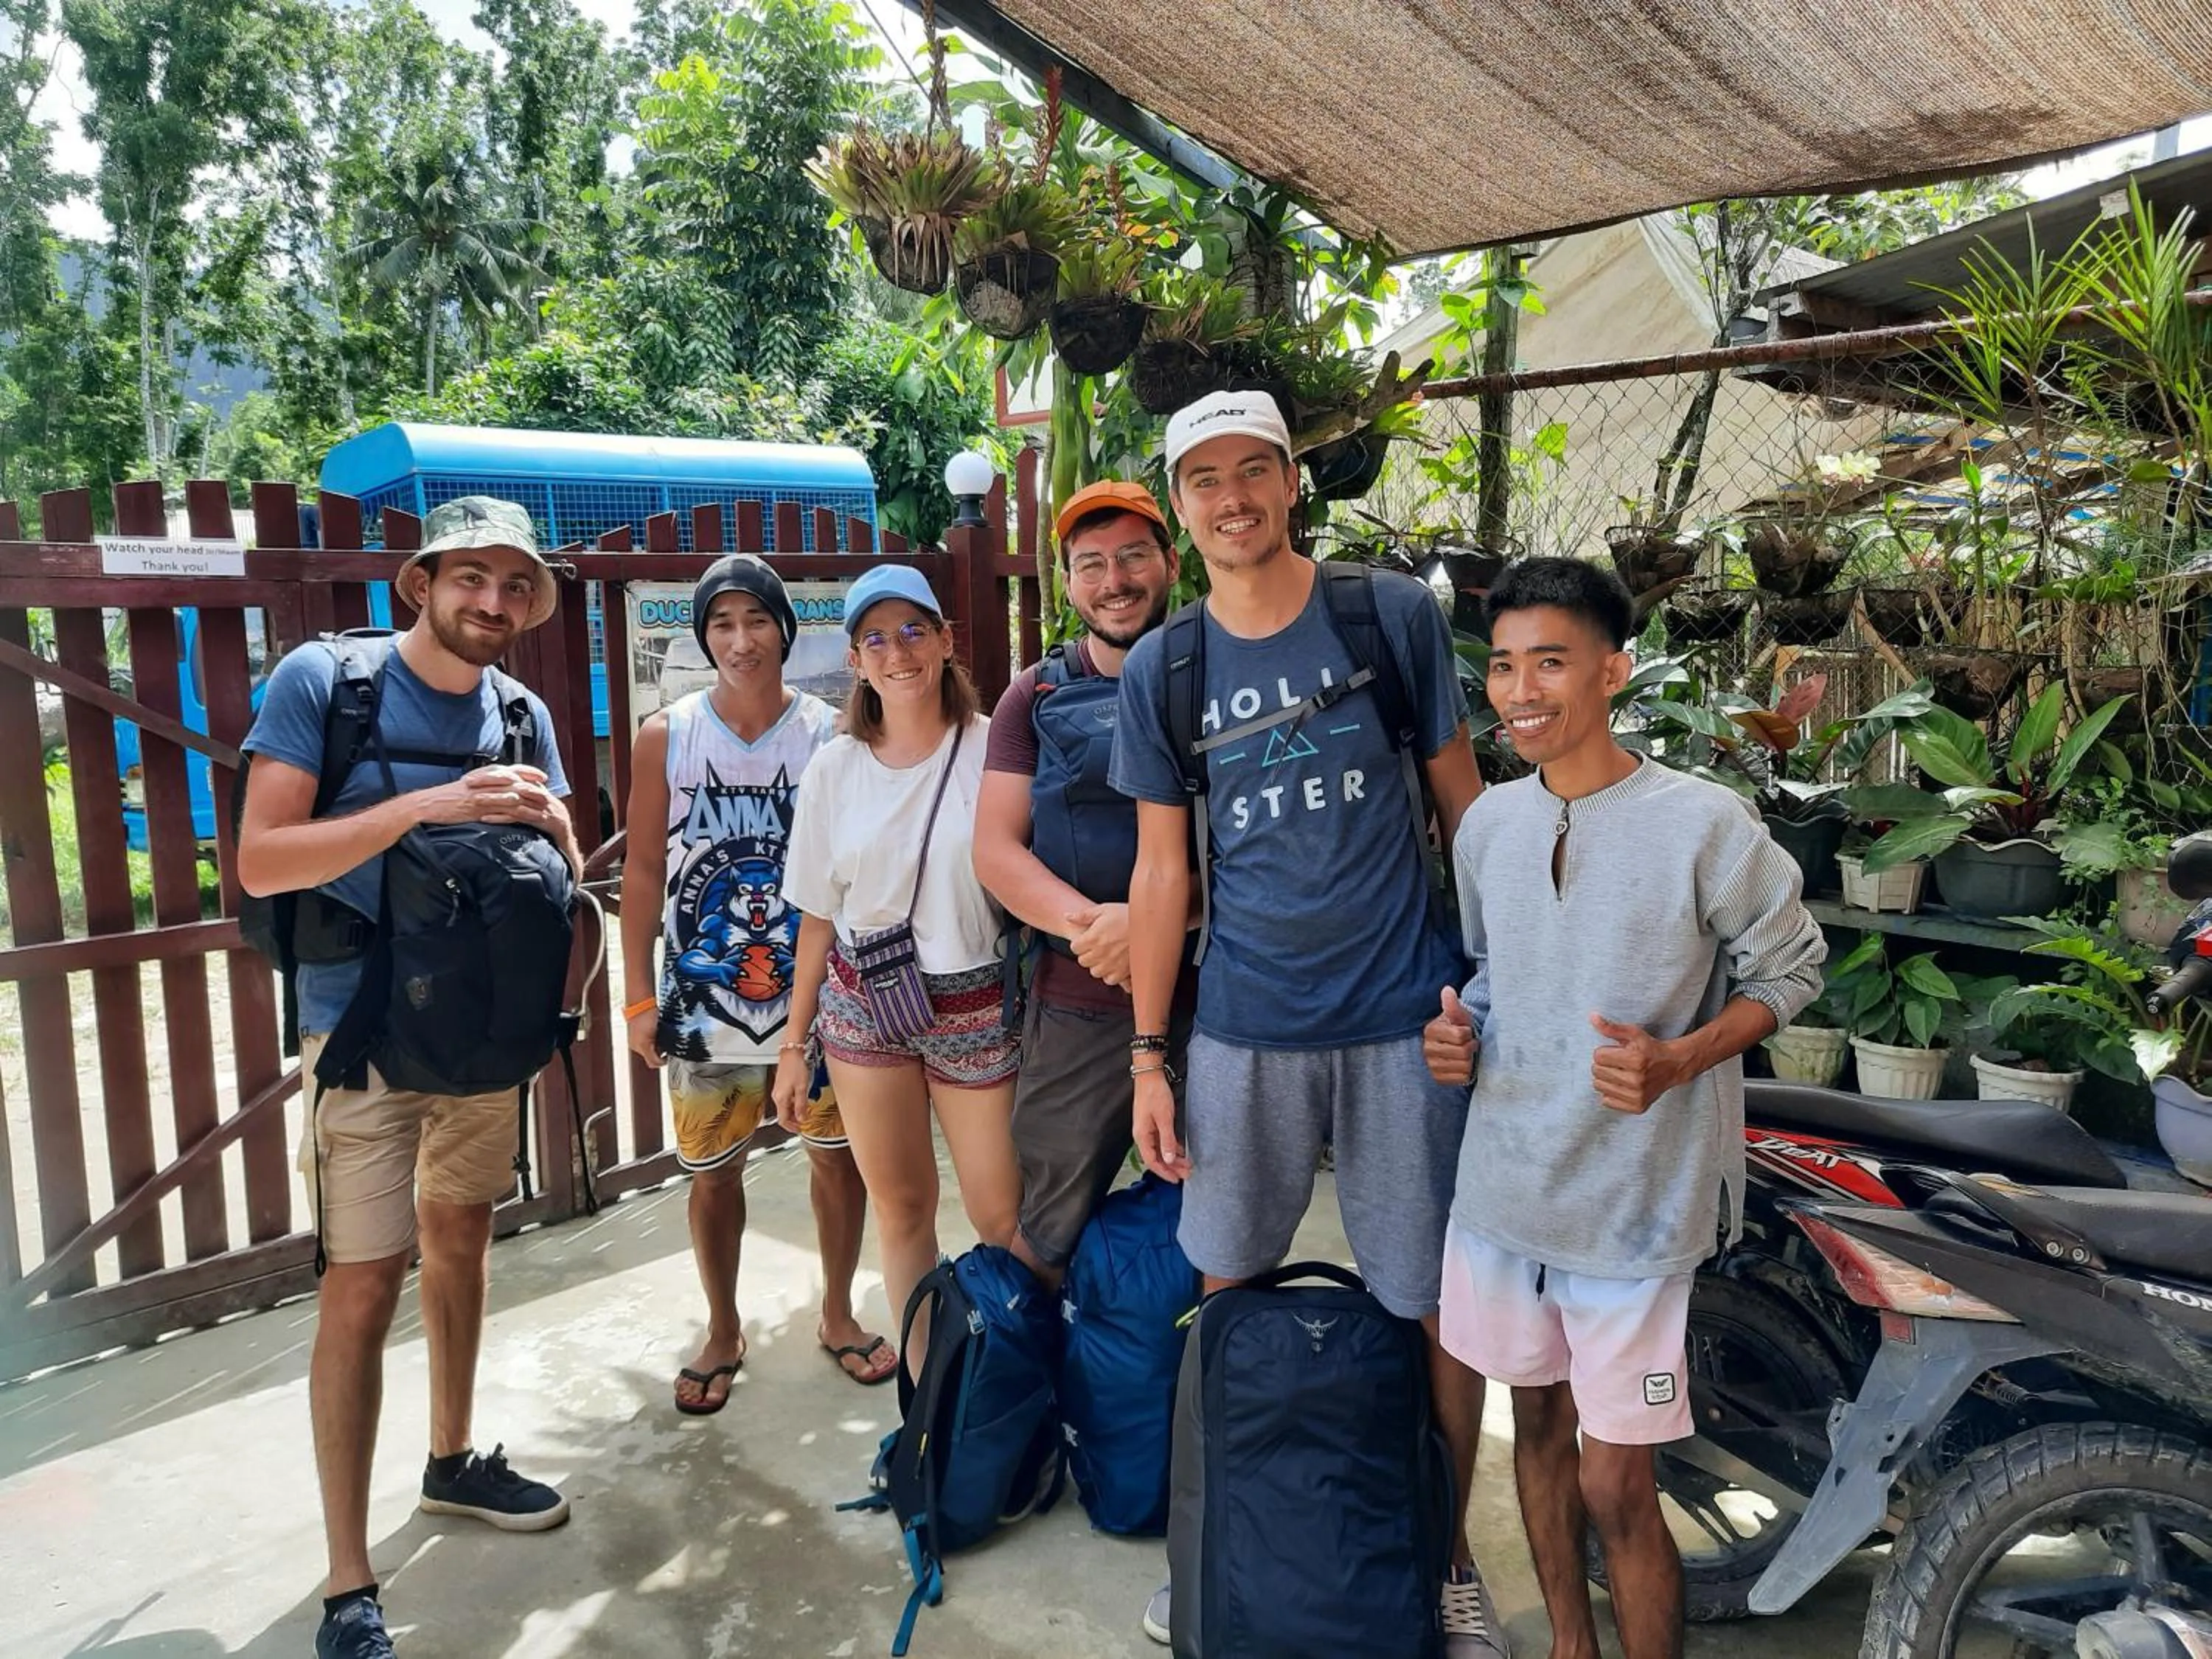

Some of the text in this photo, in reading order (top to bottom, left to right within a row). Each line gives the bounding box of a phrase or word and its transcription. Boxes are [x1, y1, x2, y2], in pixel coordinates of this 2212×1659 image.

[105, 542, 145, 553] Watch
[149, 546, 173, 555] your
[177, 545, 204, 555] head
[142, 560, 209, 572] Thank you!
[639, 599, 695, 625] DUC
[720, 786, 745, 795] KTV
[1231, 768, 1366, 830] STER
[680, 849, 730, 914] ANNA'S
